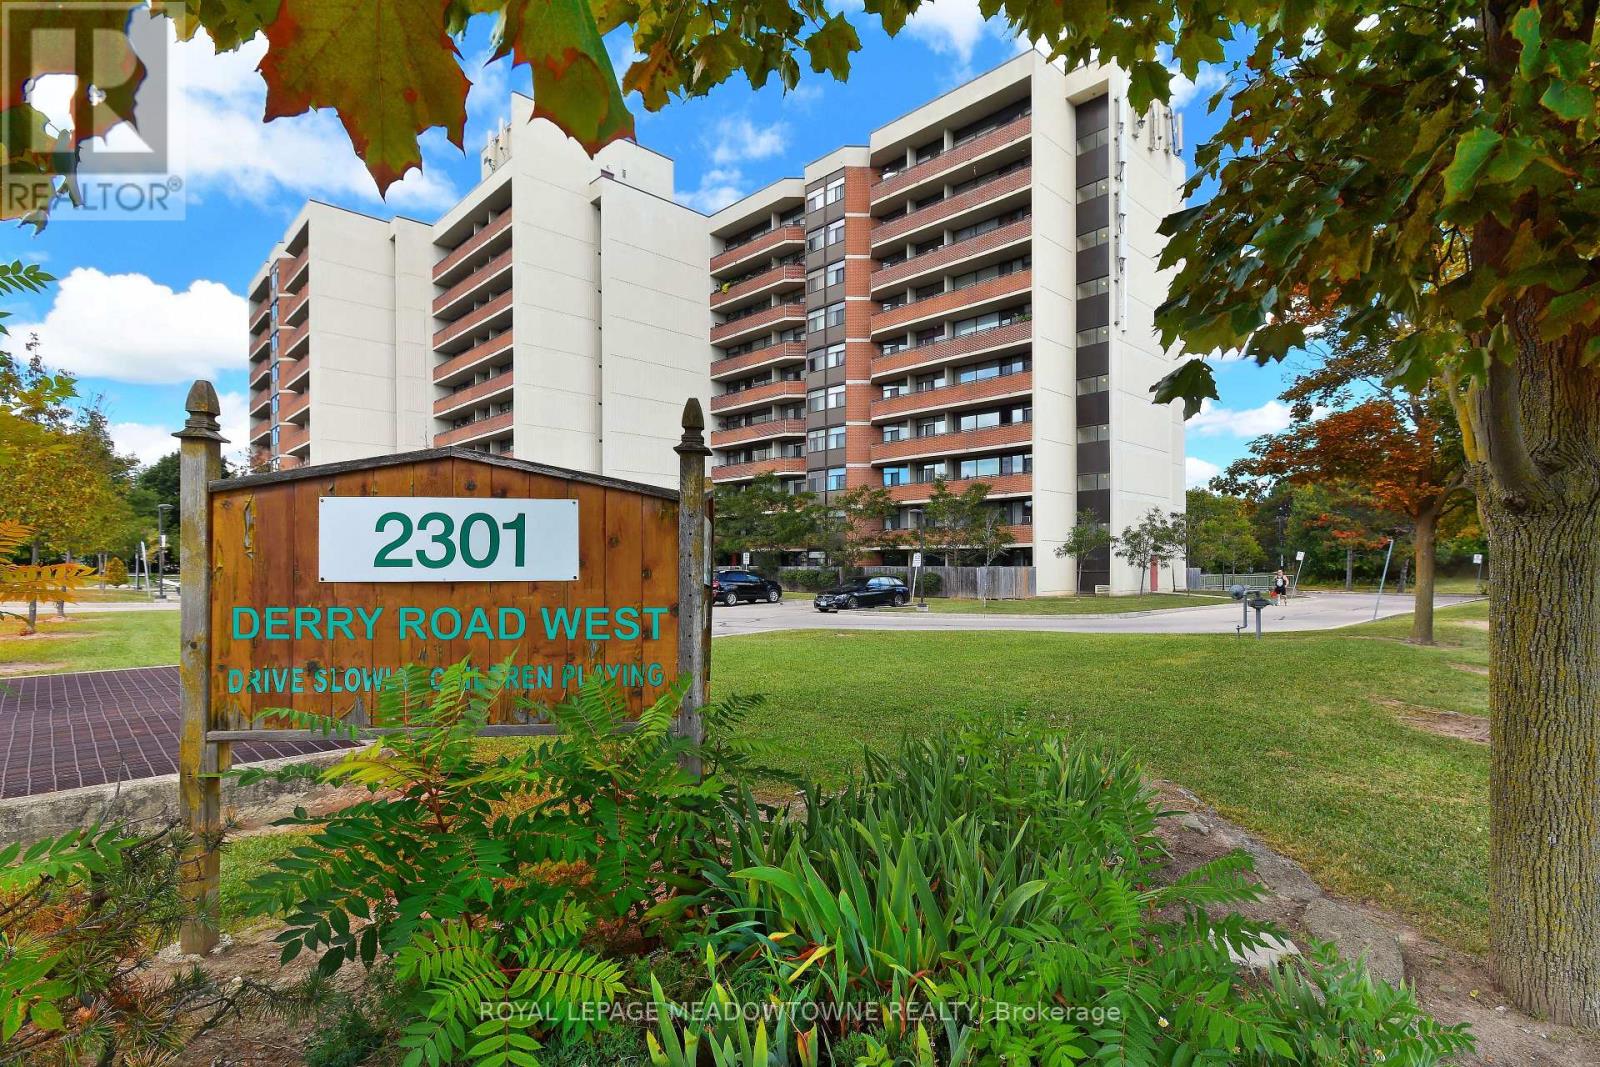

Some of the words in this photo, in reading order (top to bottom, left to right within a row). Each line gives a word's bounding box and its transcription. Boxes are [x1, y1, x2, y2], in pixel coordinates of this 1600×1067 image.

[374, 512, 526, 568] 2301
[232, 607, 384, 640] DERRY
[400, 607, 526, 640] ROAD
[541, 607, 668, 640] WEST
[228, 667, 304, 694] DRIVE
[313, 666, 410, 694] SLOWL
